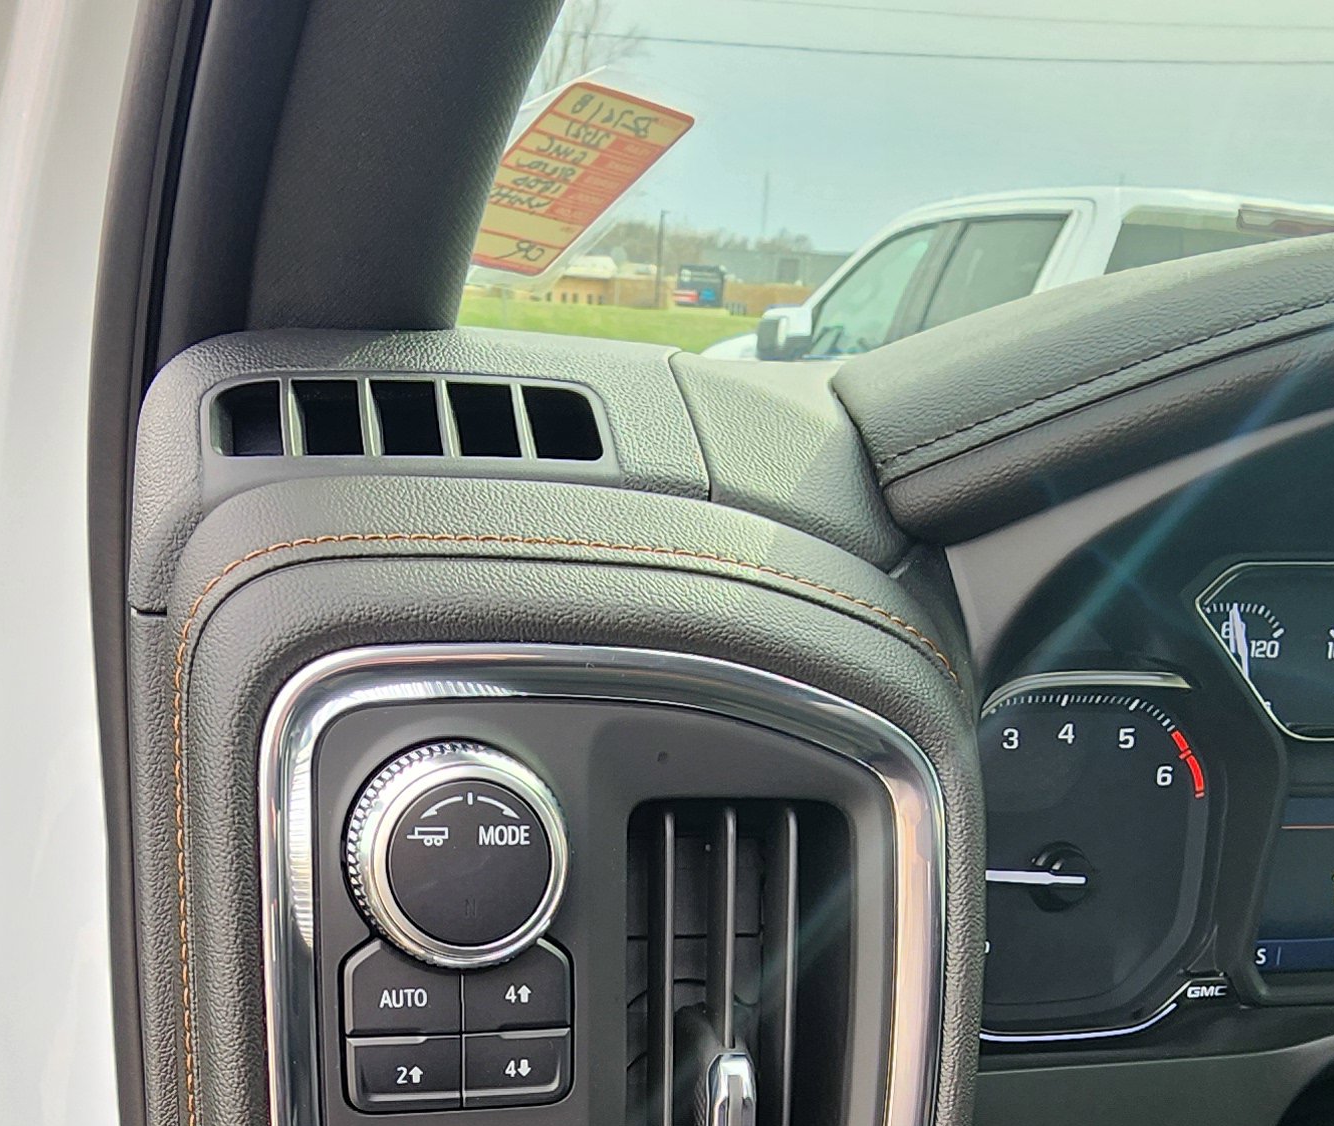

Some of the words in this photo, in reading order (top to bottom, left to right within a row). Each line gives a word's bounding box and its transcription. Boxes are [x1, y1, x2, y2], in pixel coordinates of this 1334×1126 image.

[1250, 641, 1279, 659] 120
[1002, 728, 1019, 749] 3
[1058, 723, 1075, 744] 4
[1118, 728, 1135, 749] 5
[1156, 765, 1173, 786] 6
[478, 825, 530, 846] MODE
[379, 988, 428, 1009] AUTO
[505, 985, 517, 1004] 4
[1186, 984, 1227, 999] GMC
[396, 1067, 408, 1085] 2
[505, 1060, 517, 1078] 4
